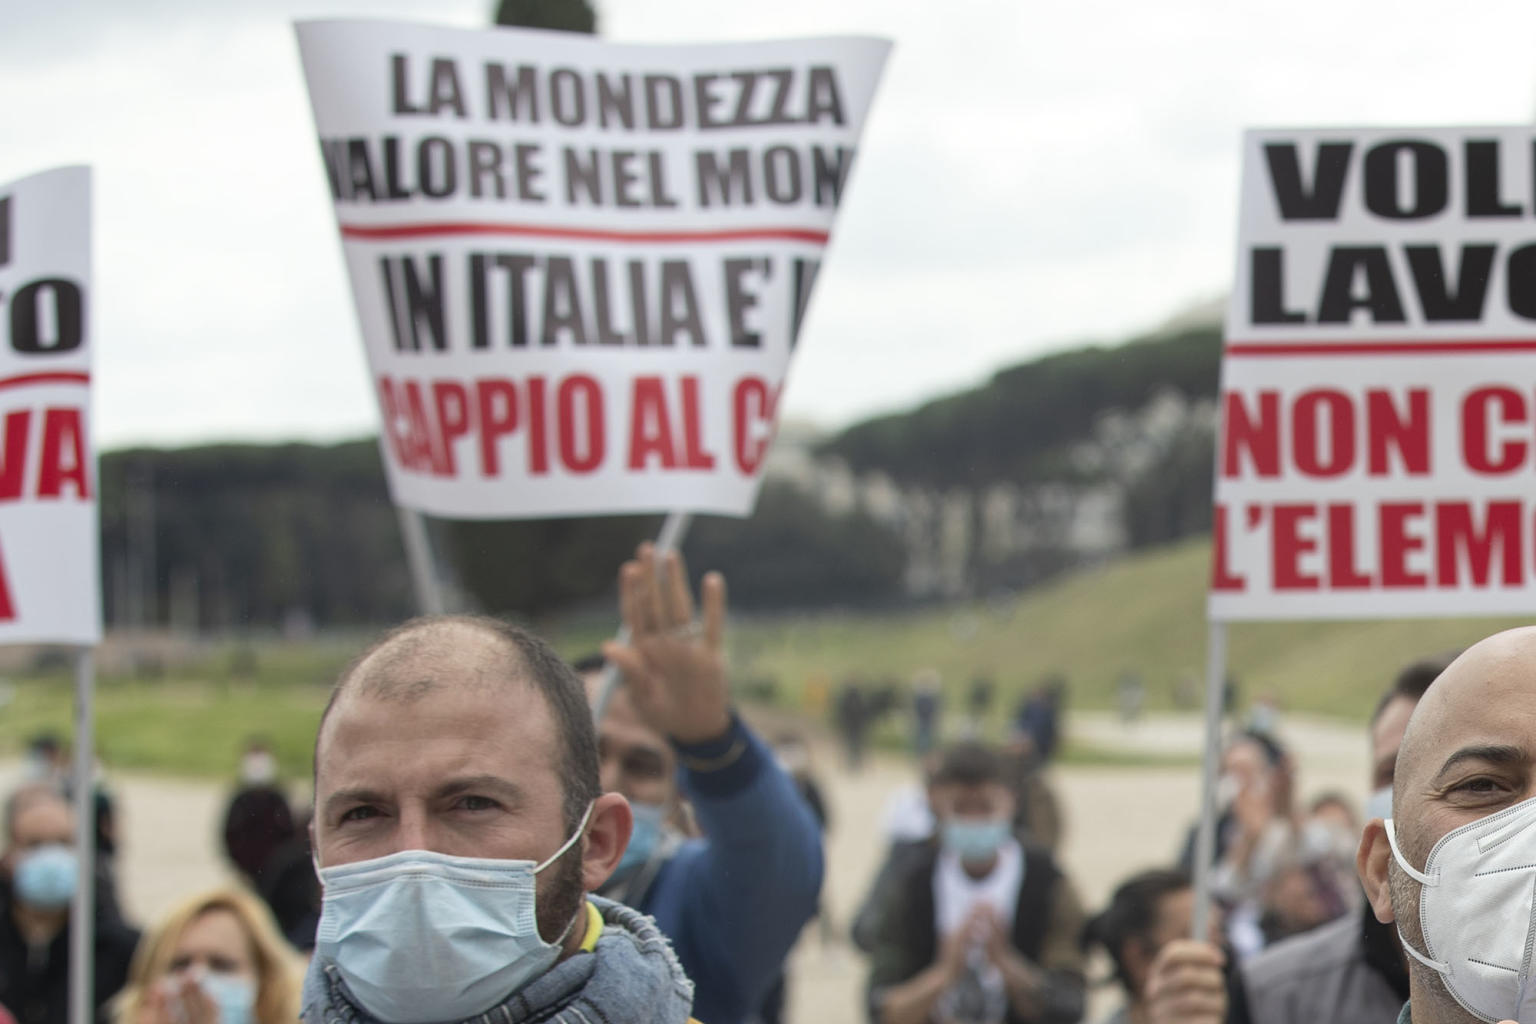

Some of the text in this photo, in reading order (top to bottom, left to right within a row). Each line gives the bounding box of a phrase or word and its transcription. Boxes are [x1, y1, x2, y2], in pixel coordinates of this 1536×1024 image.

[391, 53, 848, 131] LA MONDEZZA
[562, 146, 679, 209] NEL
[379, 253, 449, 351] IN
[467, 251, 707, 351] ITALIA
[626, 375, 715, 472] AL
[1221, 388, 1431, 479] NON
